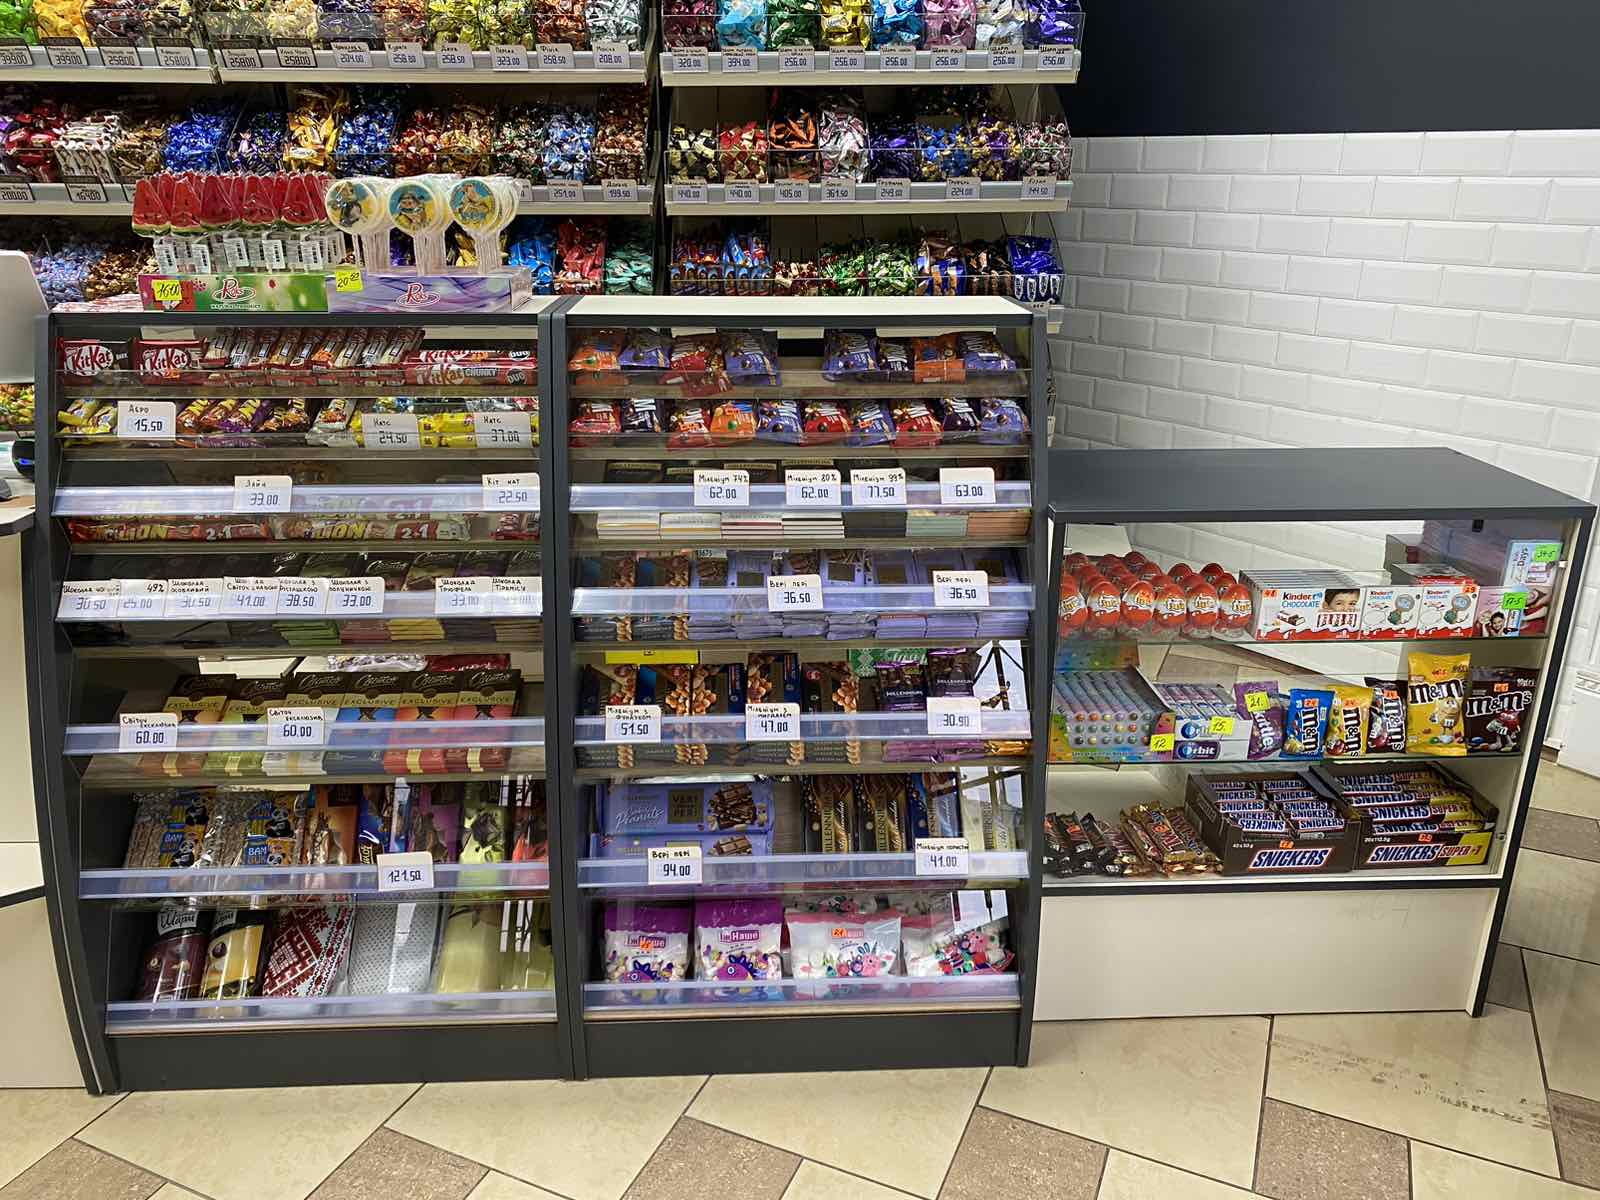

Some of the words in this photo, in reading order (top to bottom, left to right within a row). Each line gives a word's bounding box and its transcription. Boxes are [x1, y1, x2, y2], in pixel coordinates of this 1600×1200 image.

[70, 345, 112, 375] KitKat
[134, 418, 163, 432] 15.50
[498, 490, 527, 503] 22.50
[709, 487, 737, 499] 62.00
[801, 486, 829, 499] 62.00
[867, 486, 895, 498] 77.50
[955, 484, 983, 497] 63.00
[248, 493, 279, 506] 33.00
[784, 591, 811, 604] 36.50
[949, 587, 977, 599] 36.50
[1283, 591, 1311, 601] Kinder
[285, 594, 315, 607] 38.50
[342, 594, 372, 607] 33.00
[1466, 691, 1533, 717] m&m's
[283, 725, 312, 737] 60.00
[621, 722, 649, 736] 51.50
[136, 730, 164, 744] 60.00
[1177, 741, 1217, 759] Orbit
[1220, 802, 1264, 811] SNICKERS
[1284, 802, 1328, 811] SNICKERS
[1372, 805, 1429, 819] SNICKERS
[1300, 819, 1345, 830] SNICKERS
[1252, 850, 1328, 867] SNICKERS
[1371, 845, 1440, 862] SNICKERS
[1440, 846, 1471, 857] SUPER
[663, 863, 691, 877] 94.00
